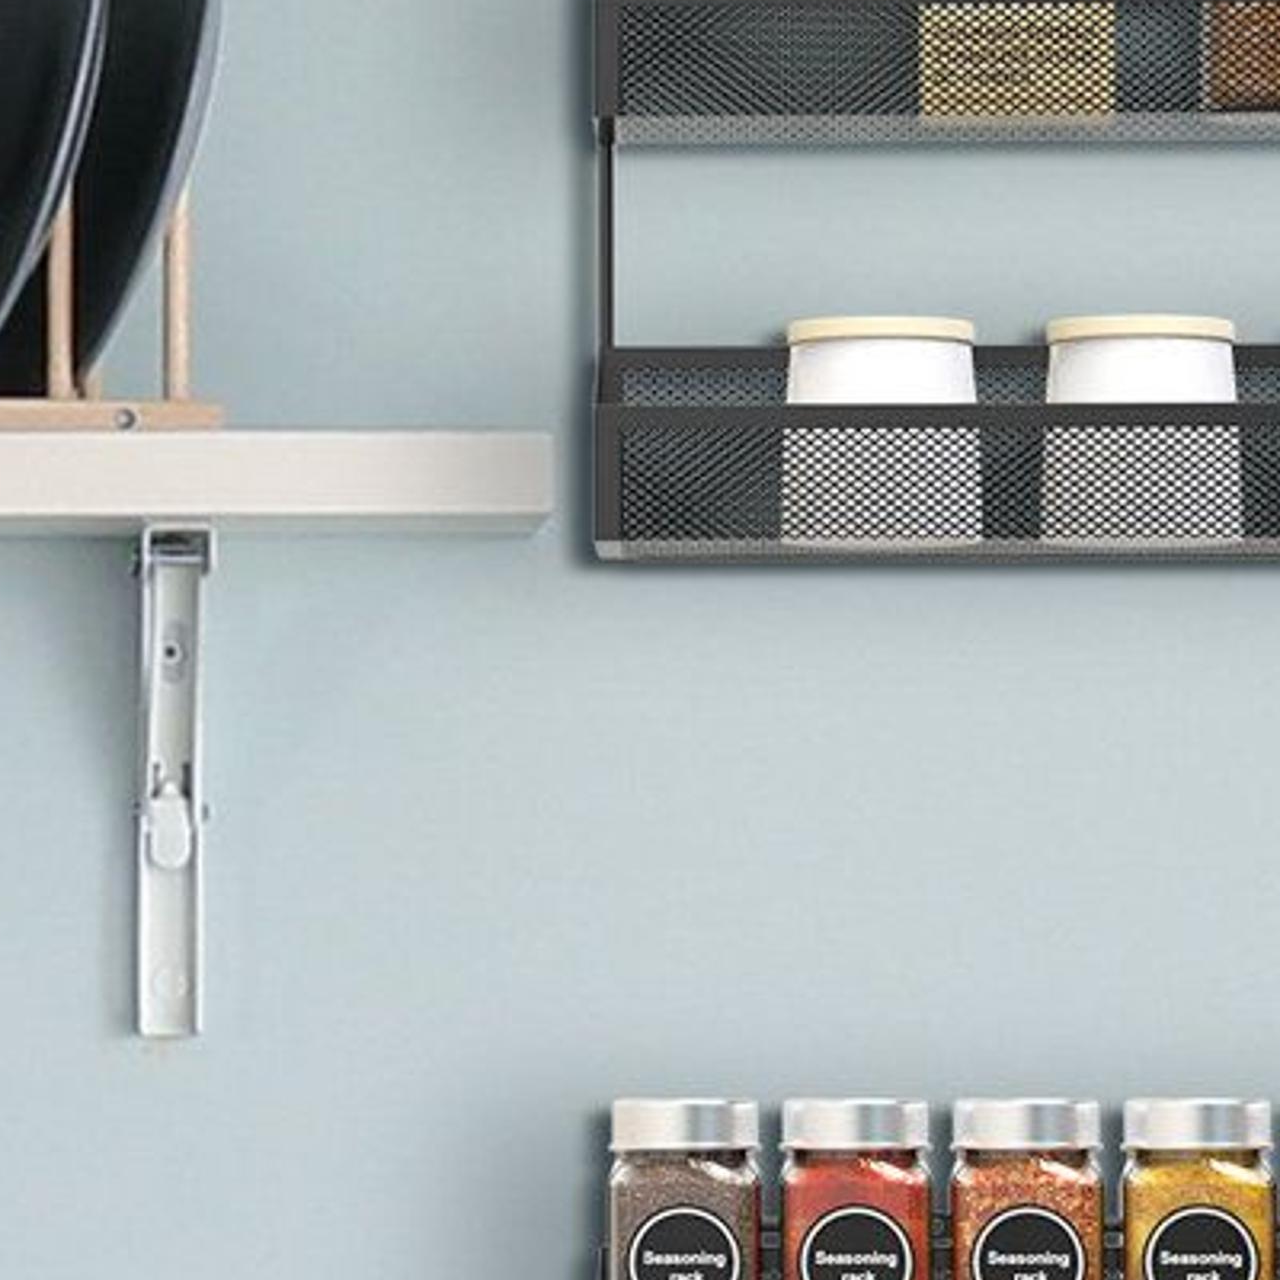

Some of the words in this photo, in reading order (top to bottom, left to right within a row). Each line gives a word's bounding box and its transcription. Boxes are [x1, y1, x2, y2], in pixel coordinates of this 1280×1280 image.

[642, 1250, 728, 1269] Seasoning
[814, 1250, 898, 1269] Seasoning
[987, 1250, 1071, 1269] Seasoning
[1159, 1250, 1243, 1269] Seasoning
